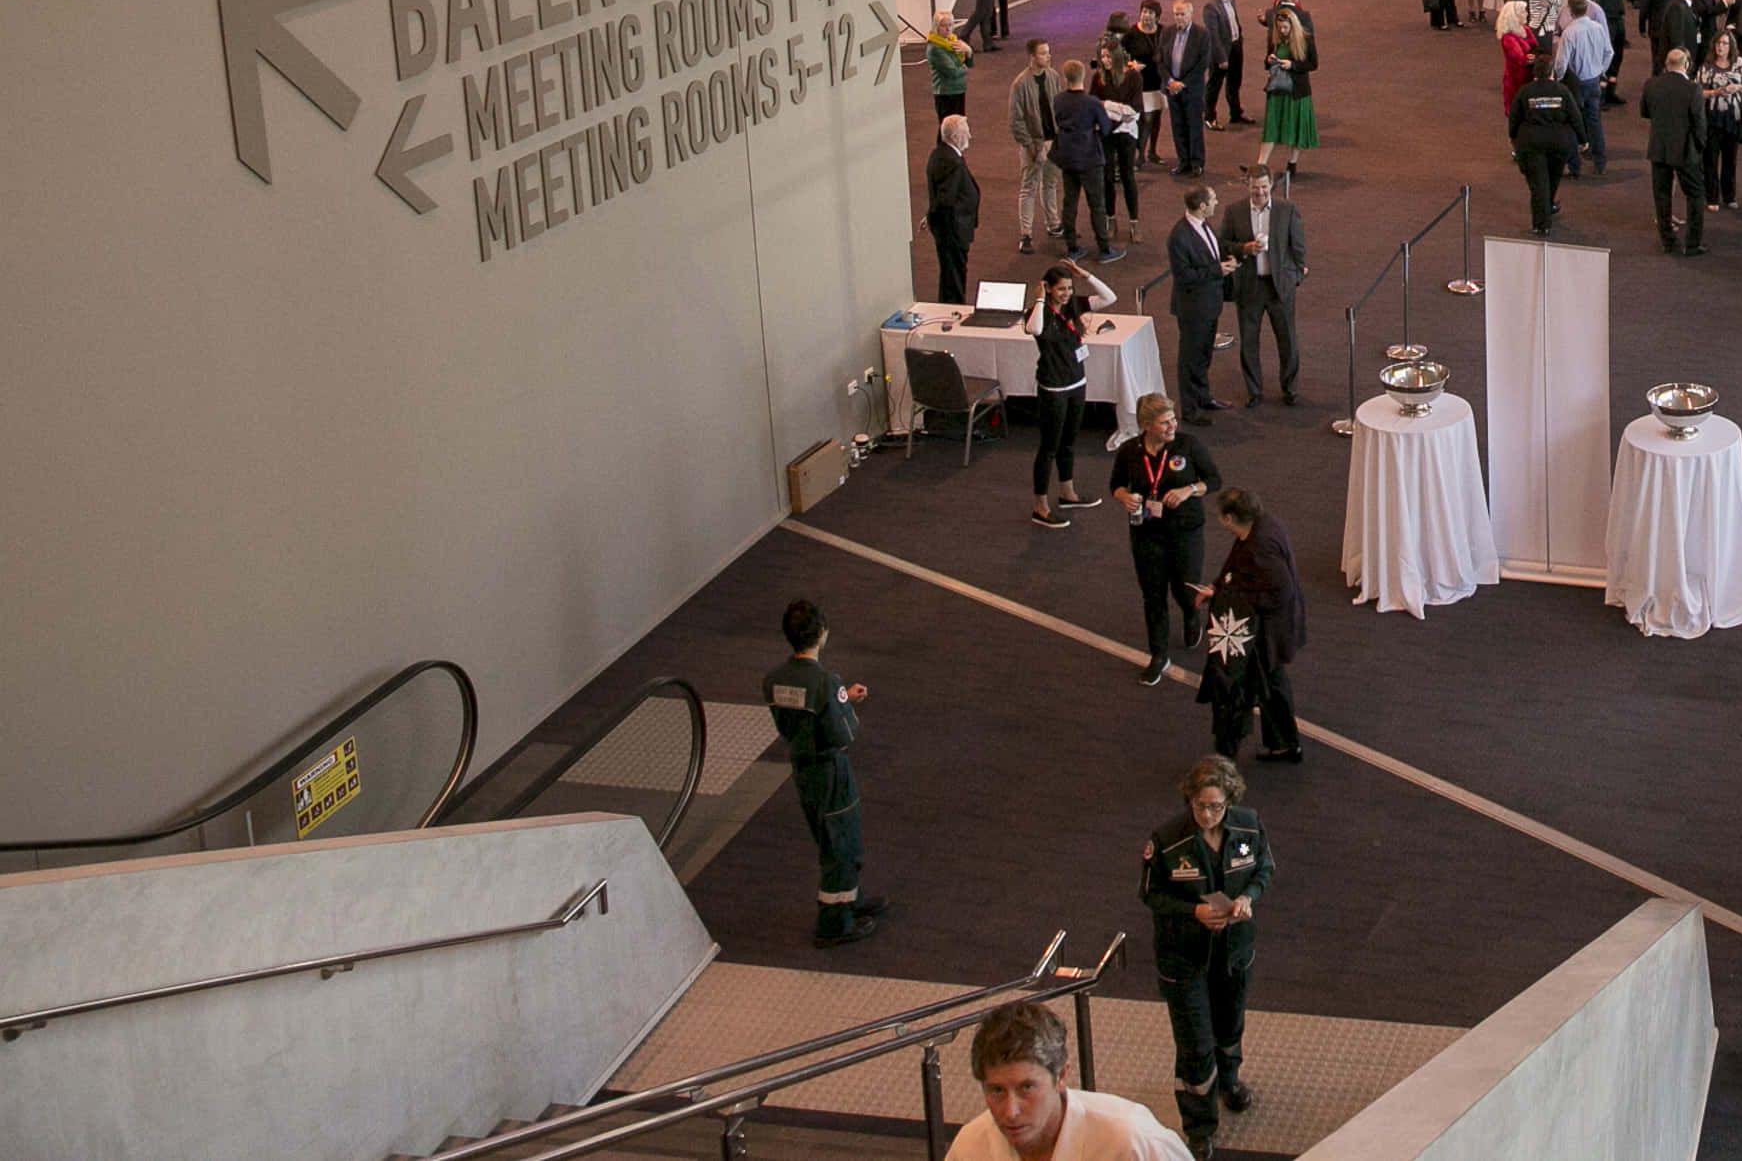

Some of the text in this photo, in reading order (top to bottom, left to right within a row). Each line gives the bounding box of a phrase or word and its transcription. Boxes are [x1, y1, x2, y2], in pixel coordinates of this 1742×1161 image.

[463, 14, 645, 162] MEETING
[473, 12, 858, 263] MEETING ROOMS 5-12
